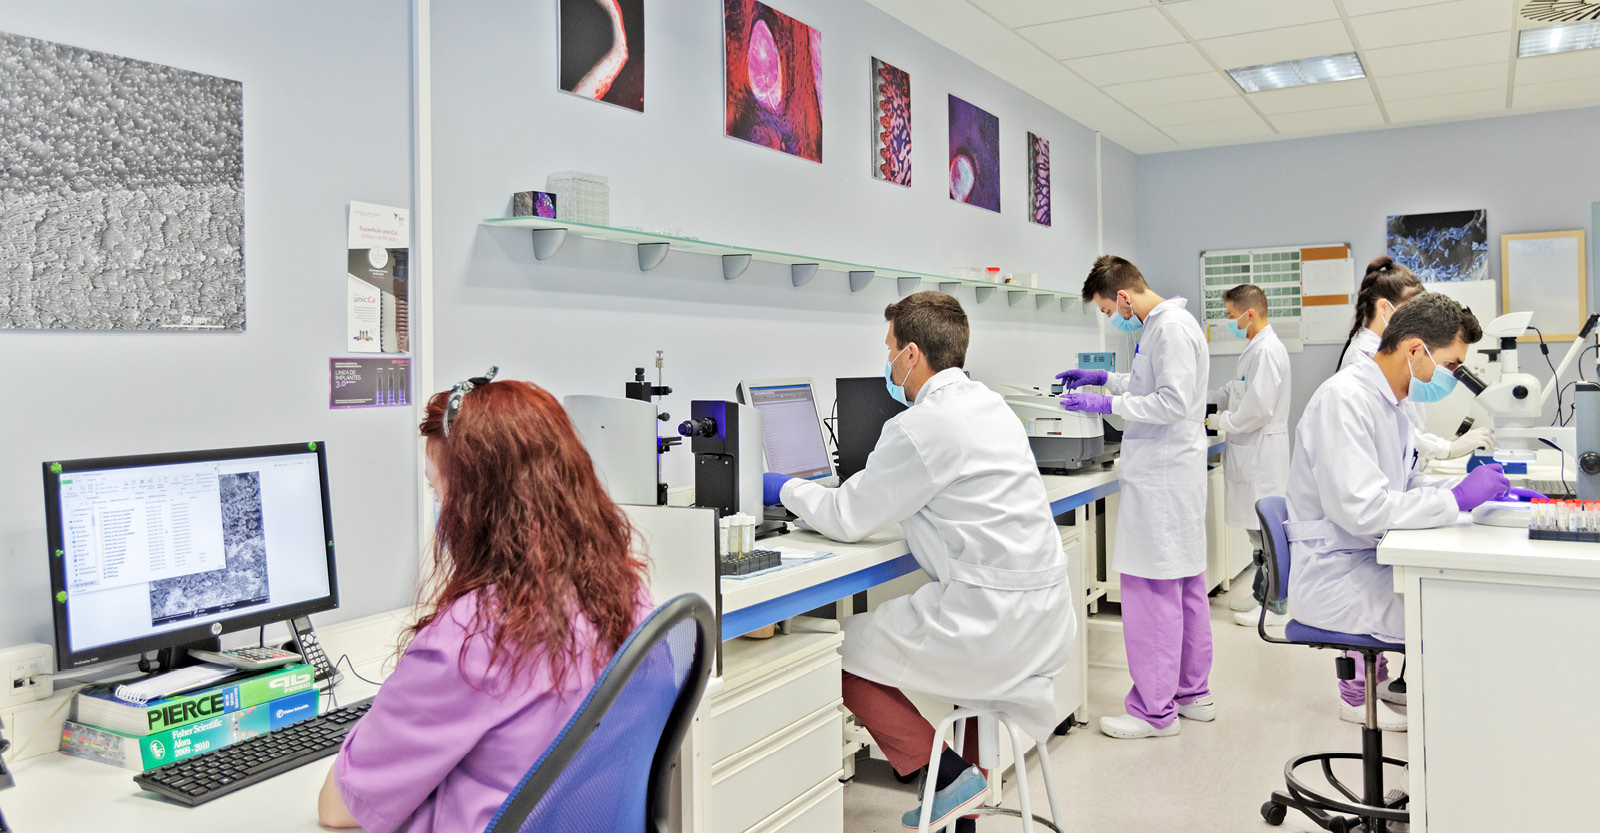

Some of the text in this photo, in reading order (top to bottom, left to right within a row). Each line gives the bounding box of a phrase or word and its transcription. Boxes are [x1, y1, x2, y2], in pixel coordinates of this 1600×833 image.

[181, 315, 192, 324] 50
[284, 682, 311, 694] PERBIO
[147, 693, 225, 730] PIERCE
[172, 719, 223, 740] Fisher Scientific
[174, 738, 191, 749] Afora
[174, 746, 191, 758] 2009
[194, 740, 210, 753] 2010
